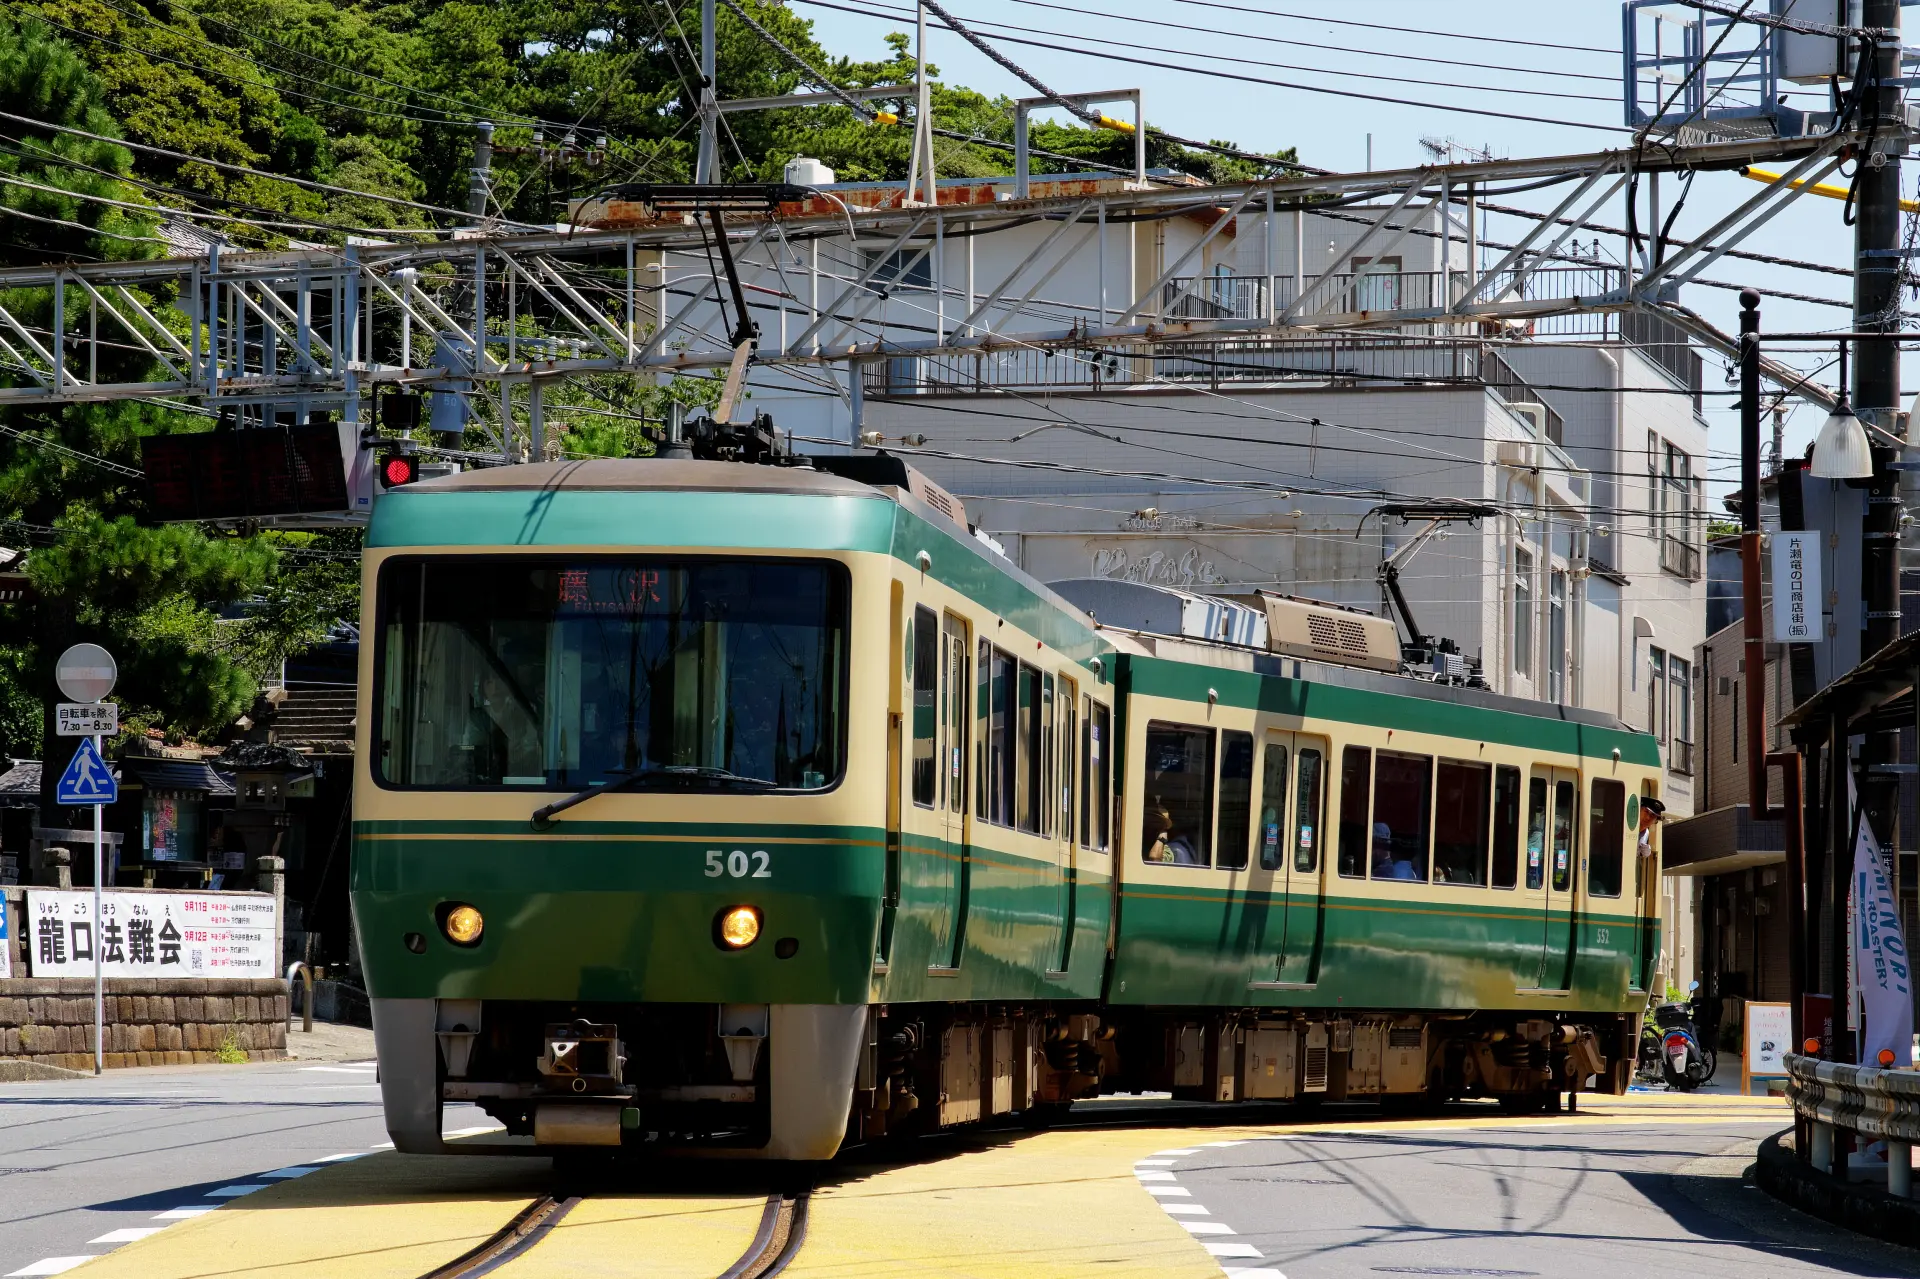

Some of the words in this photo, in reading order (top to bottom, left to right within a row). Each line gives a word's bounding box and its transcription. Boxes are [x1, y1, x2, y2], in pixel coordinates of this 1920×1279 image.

[60, 707, 114, 719] 自転車を除く
[704, 850, 772, 878] 502
[184, 901, 208, 912] 9月11日
[1861, 825, 1907, 994] AMINORI
[38, 917, 182, 965] 龍口法難会
[184, 931, 208, 942] 9月12日
[1596, 928, 1610, 944] 552
[1868, 901, 1888, 991] ROASTERY
